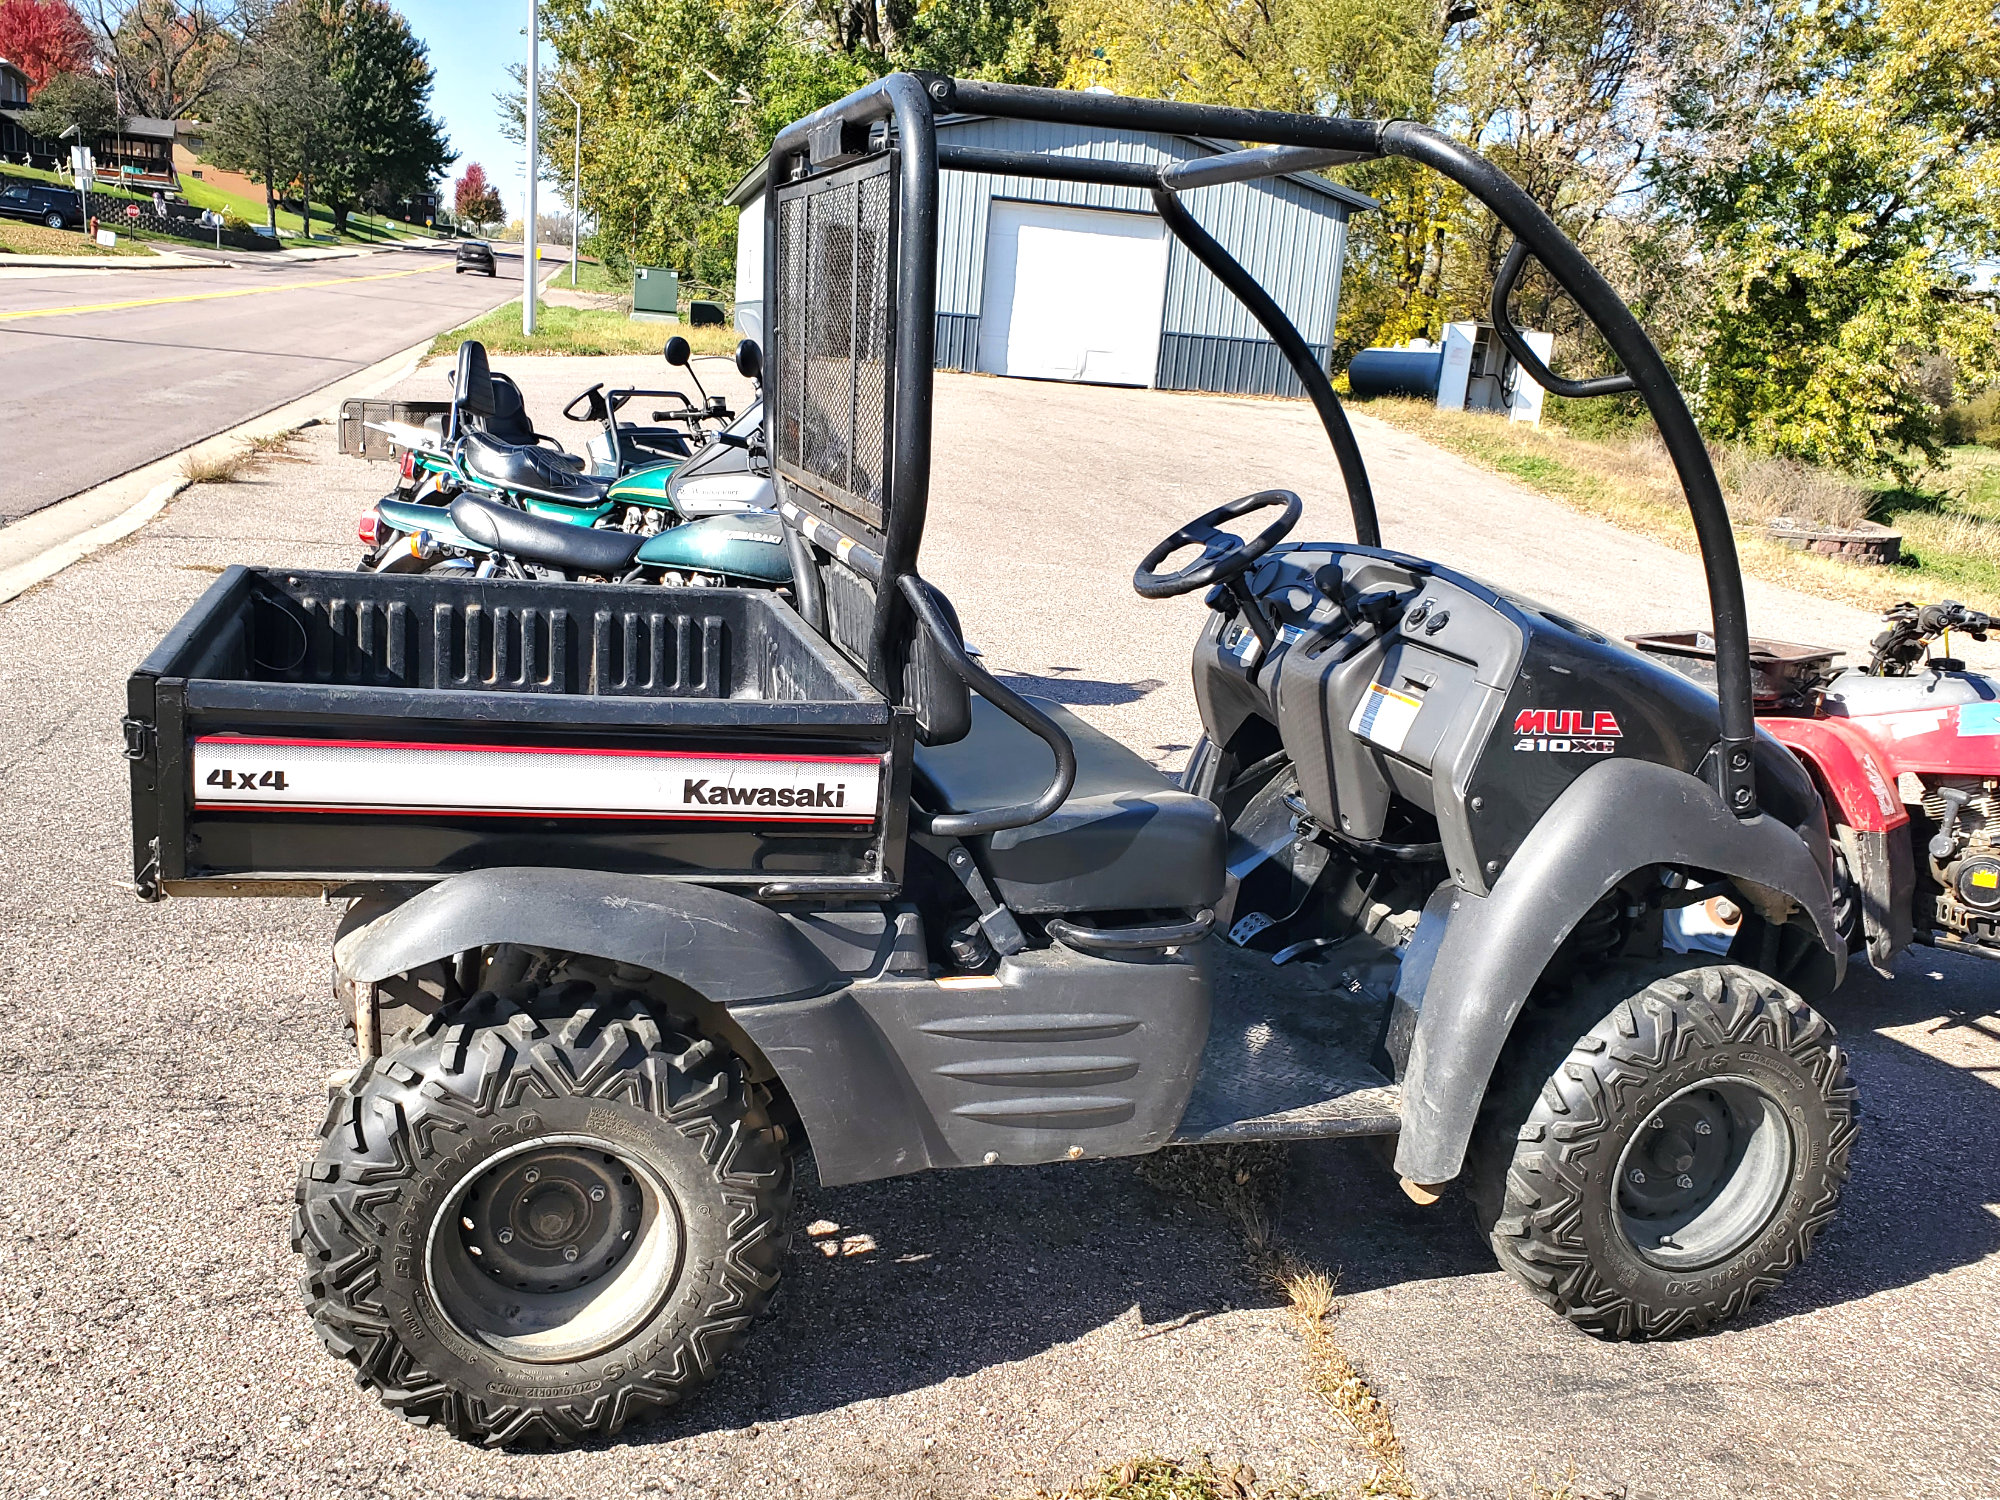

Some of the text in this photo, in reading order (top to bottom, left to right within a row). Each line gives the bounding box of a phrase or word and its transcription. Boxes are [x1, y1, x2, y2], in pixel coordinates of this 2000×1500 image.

[716, 530, 783, 545] AWASAKI
[1513, 709, 1624, 737] MULE
[206, 769, 289, 790] 4x4
[683, 779, 845, 807] Kawasaki
[394, 1137, 480, 1279] BIGHORN
[1710, 1190, 1806, 1291] BIGHORN
[1665, 1278, 1702, 1297] 2.0
[400, 1306, 425, 1341] RADIAL
[602, 1255, 715, 1381] MAXXIS
